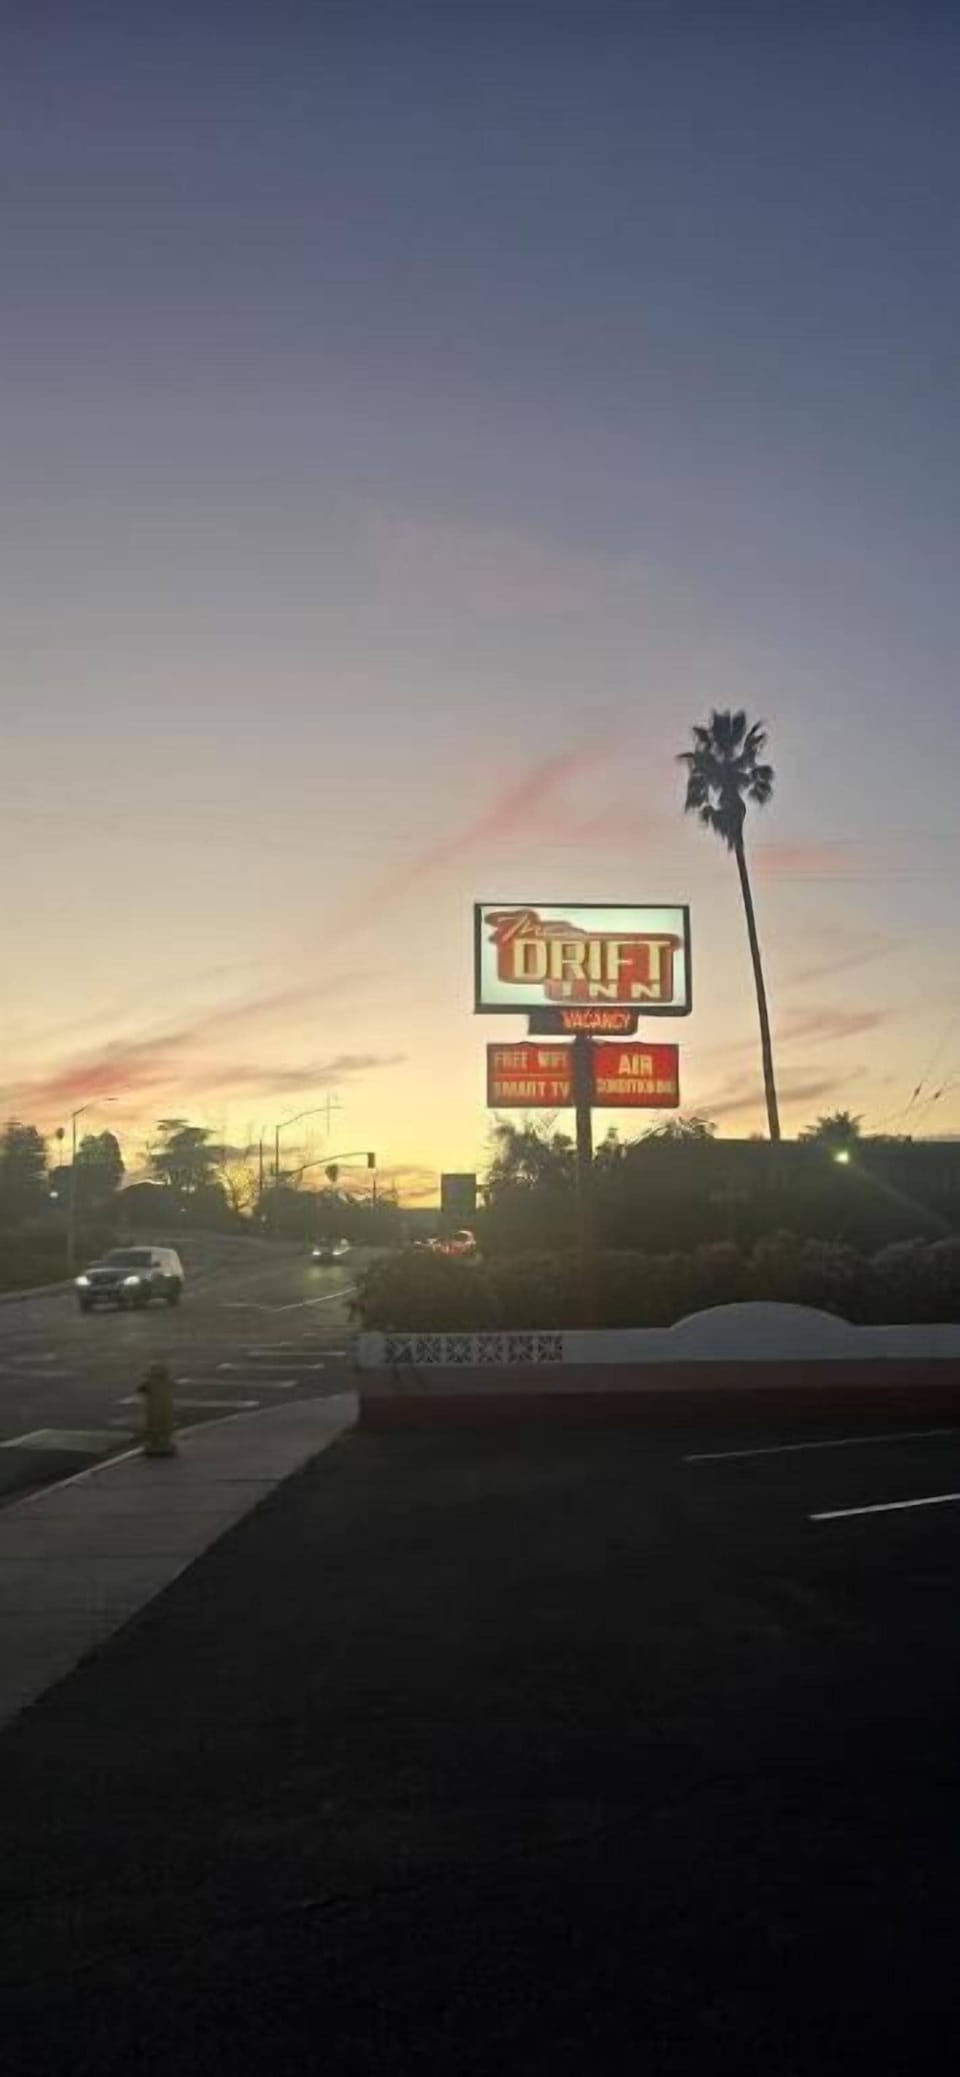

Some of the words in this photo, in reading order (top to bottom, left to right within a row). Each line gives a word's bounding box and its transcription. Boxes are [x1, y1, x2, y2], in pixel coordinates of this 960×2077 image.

[513, 939, 671, 981] DRIFT
[562, 983, 661, 999] INN
[562, 1010, 631, 1029] VACANCY
[494, 1051, 528, 1069] FREE
[618, 1054, 653, 1075] AIR
[494, 1081, 545, 1098] SMART
[551, 1081, 571, 1098] TV
